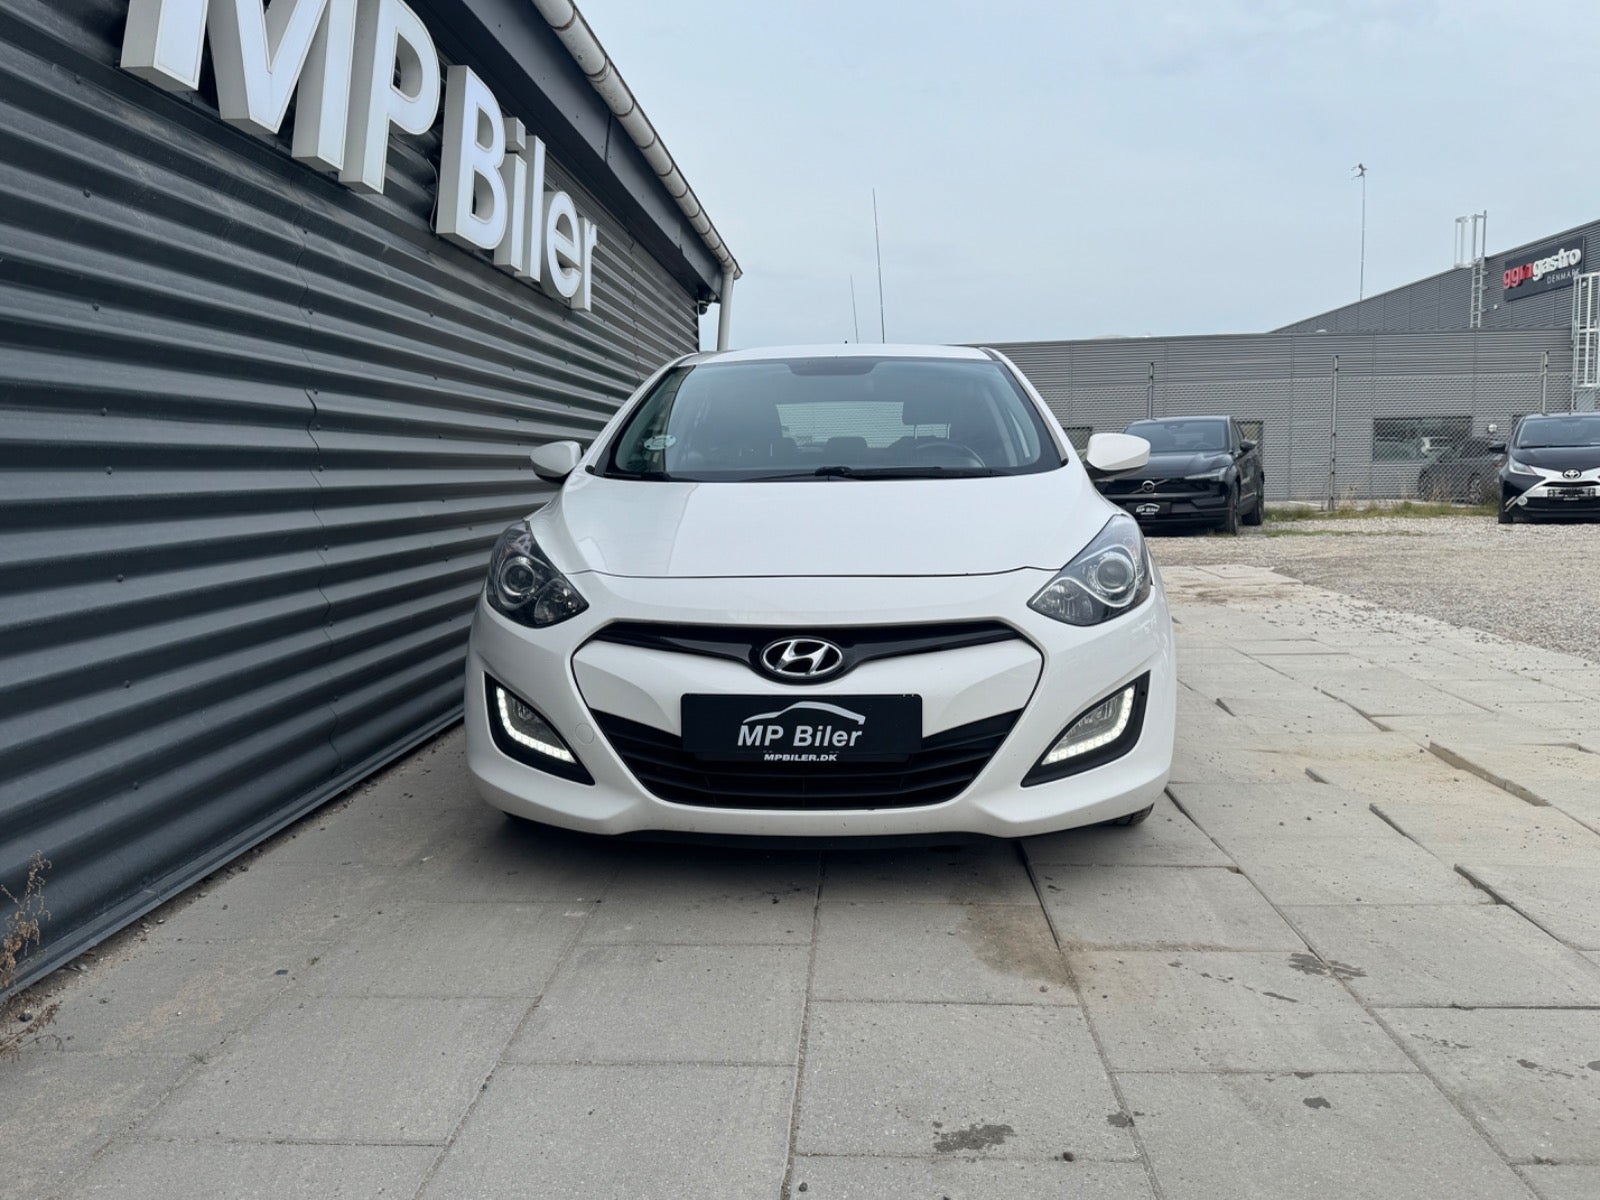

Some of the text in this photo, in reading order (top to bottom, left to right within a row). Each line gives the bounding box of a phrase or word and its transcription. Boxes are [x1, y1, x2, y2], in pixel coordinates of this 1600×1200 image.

[120, 0, 597, 312] MP Biler
[737, 724, 862, 747] MP Biler
[763, 753, 838, 762] MPBILER.DK
